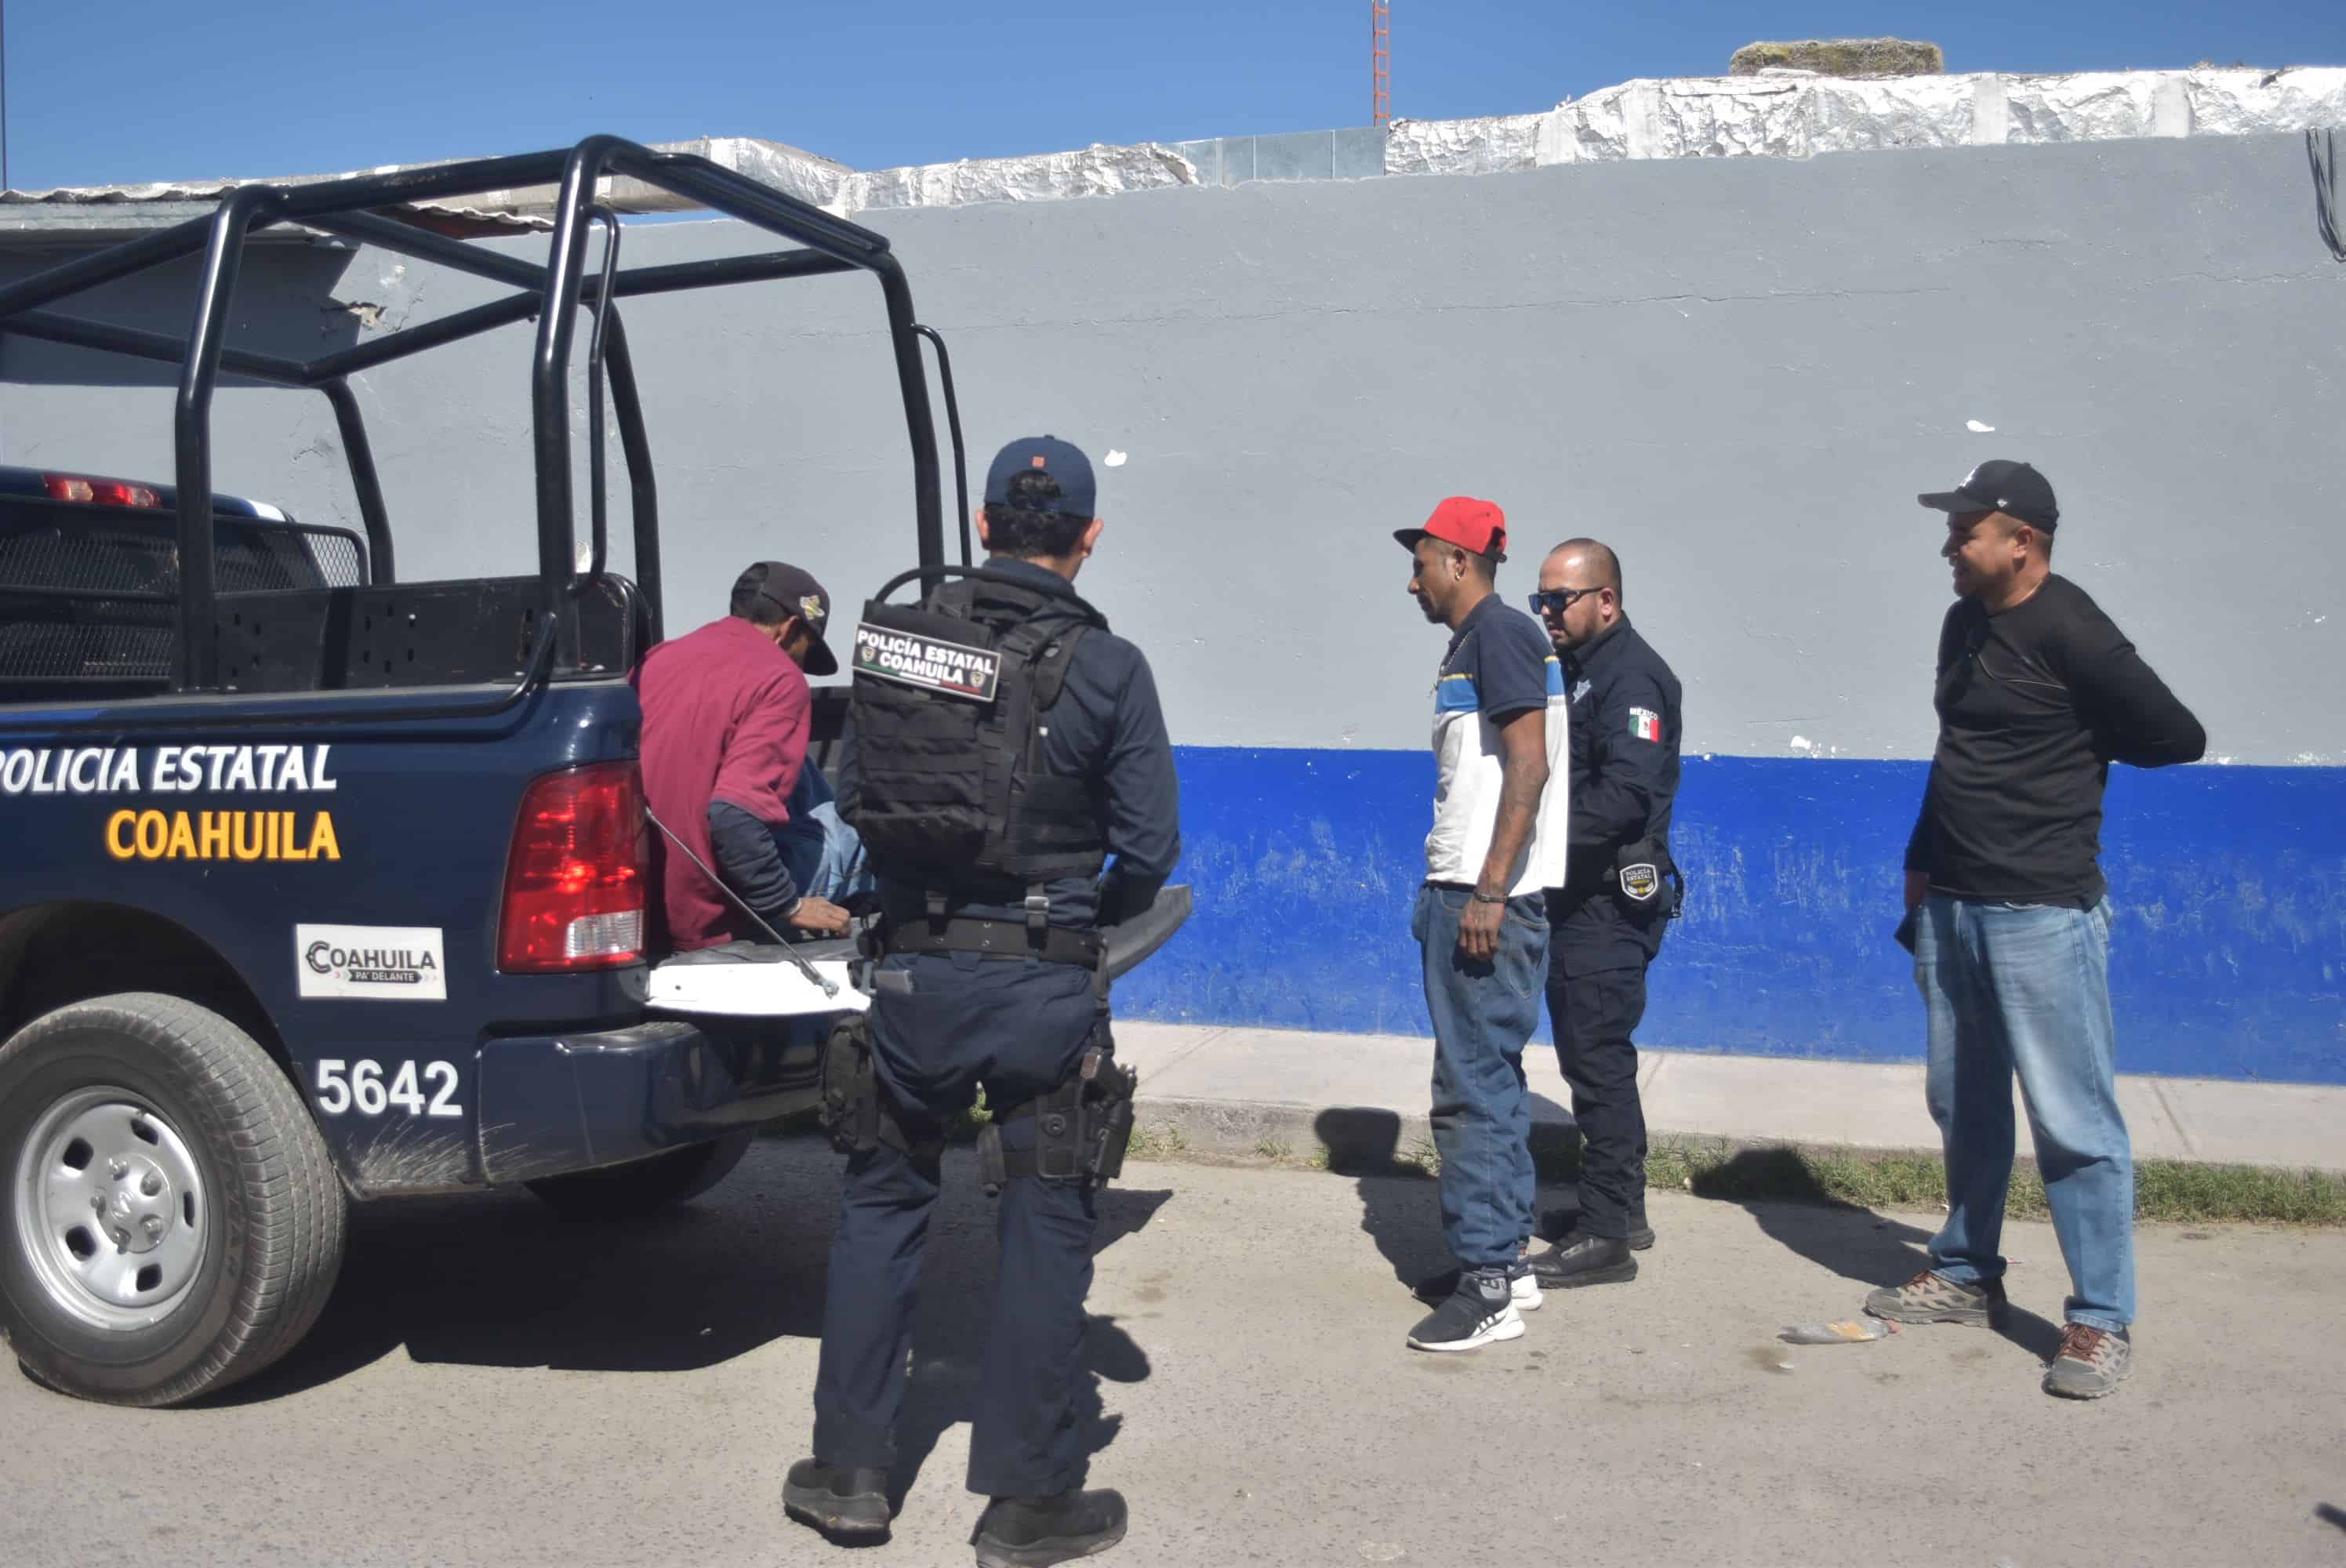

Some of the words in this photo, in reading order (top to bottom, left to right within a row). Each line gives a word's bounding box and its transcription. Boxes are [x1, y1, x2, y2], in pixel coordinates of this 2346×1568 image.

[858, 630, 921, 658] POLICÍA
[924, 646, 993, 675] ESTATAL
[879, 652, 964, 684] COAHUILA
[152, 745, 337, 790] ESTATAL
[107, 809, 340, 858] COAHUILA
[305, 940, 437, 974] COAHUILA
[372, 971, 415, 982] DELANTE
[318, 1059, 463, 1116] 5642
